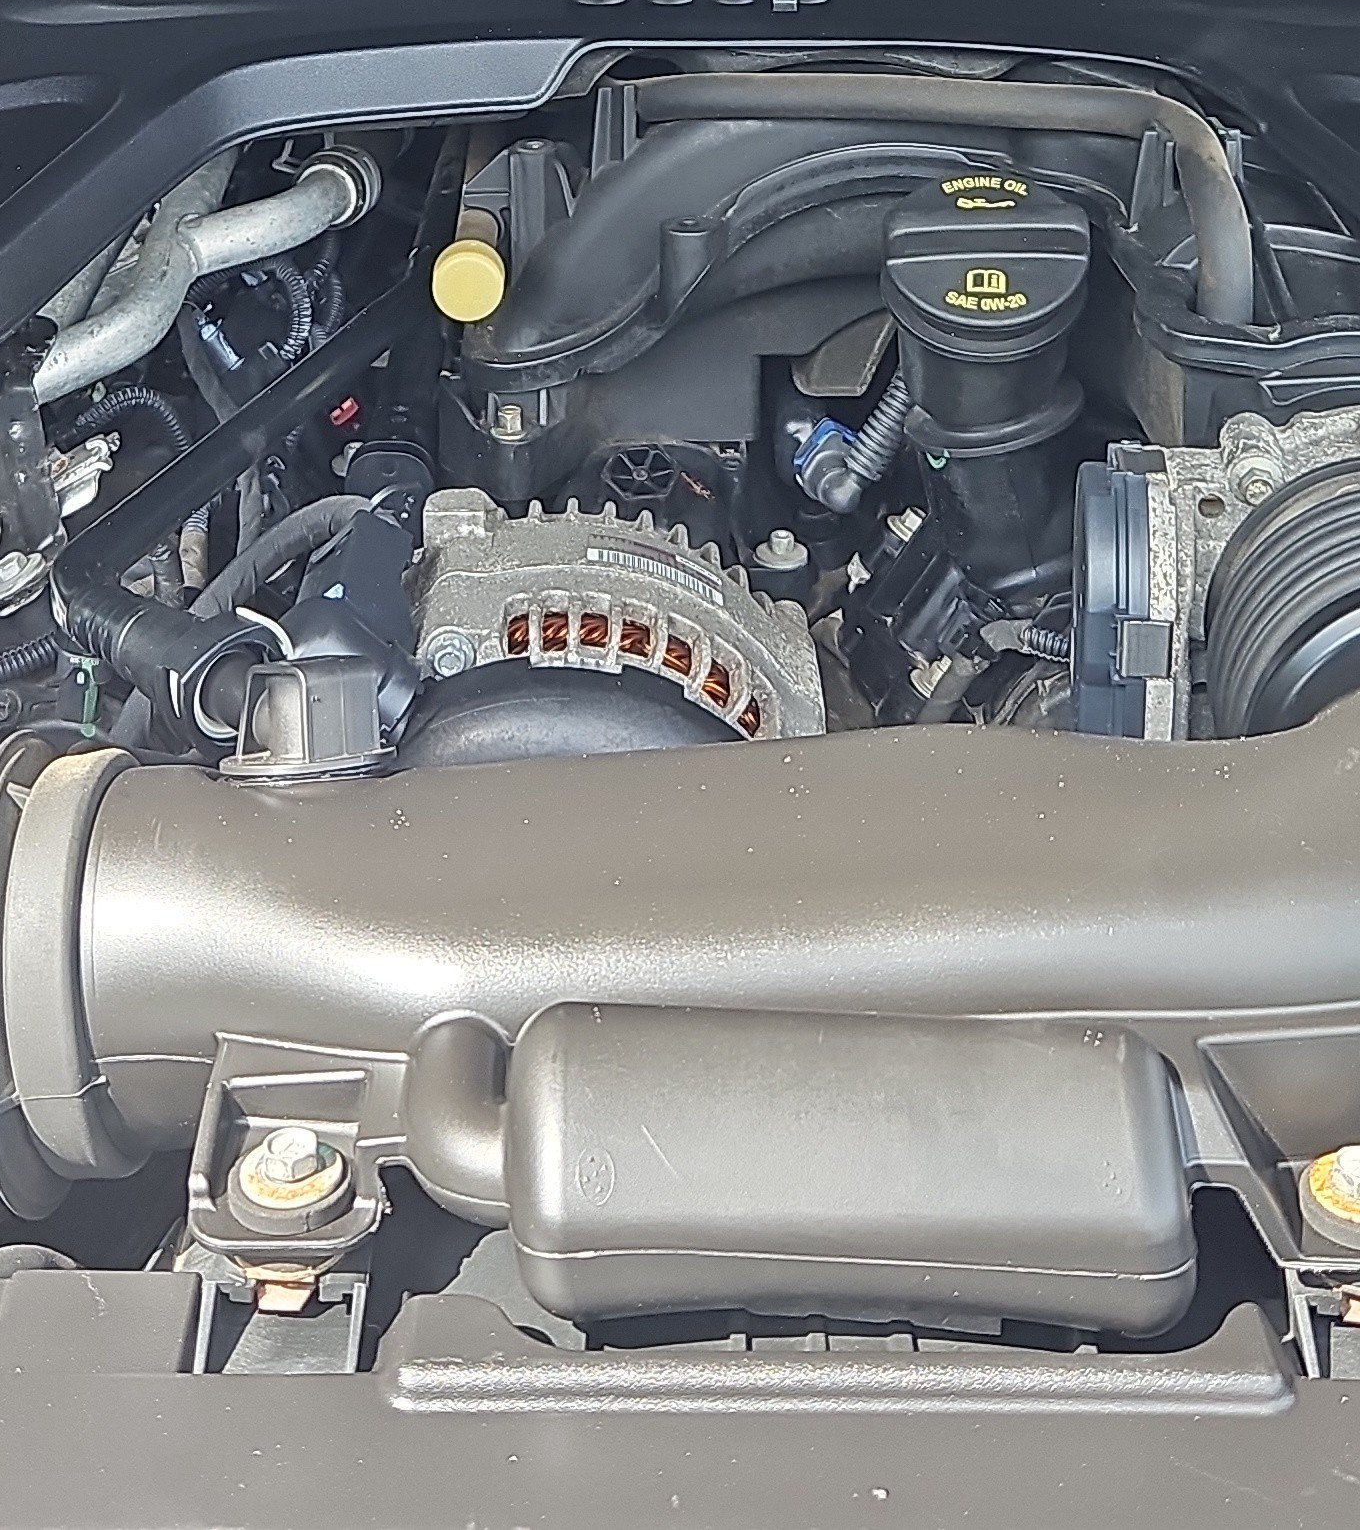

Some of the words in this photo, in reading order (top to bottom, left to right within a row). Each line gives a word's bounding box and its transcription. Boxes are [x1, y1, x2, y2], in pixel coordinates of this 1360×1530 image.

[942, 177, 1001, 194] ENGINE
[1004, 180, 1029, 196] OIL
[945, 292, 978, 310] SAE
[981, 294, 1027, 311] 0W-20
